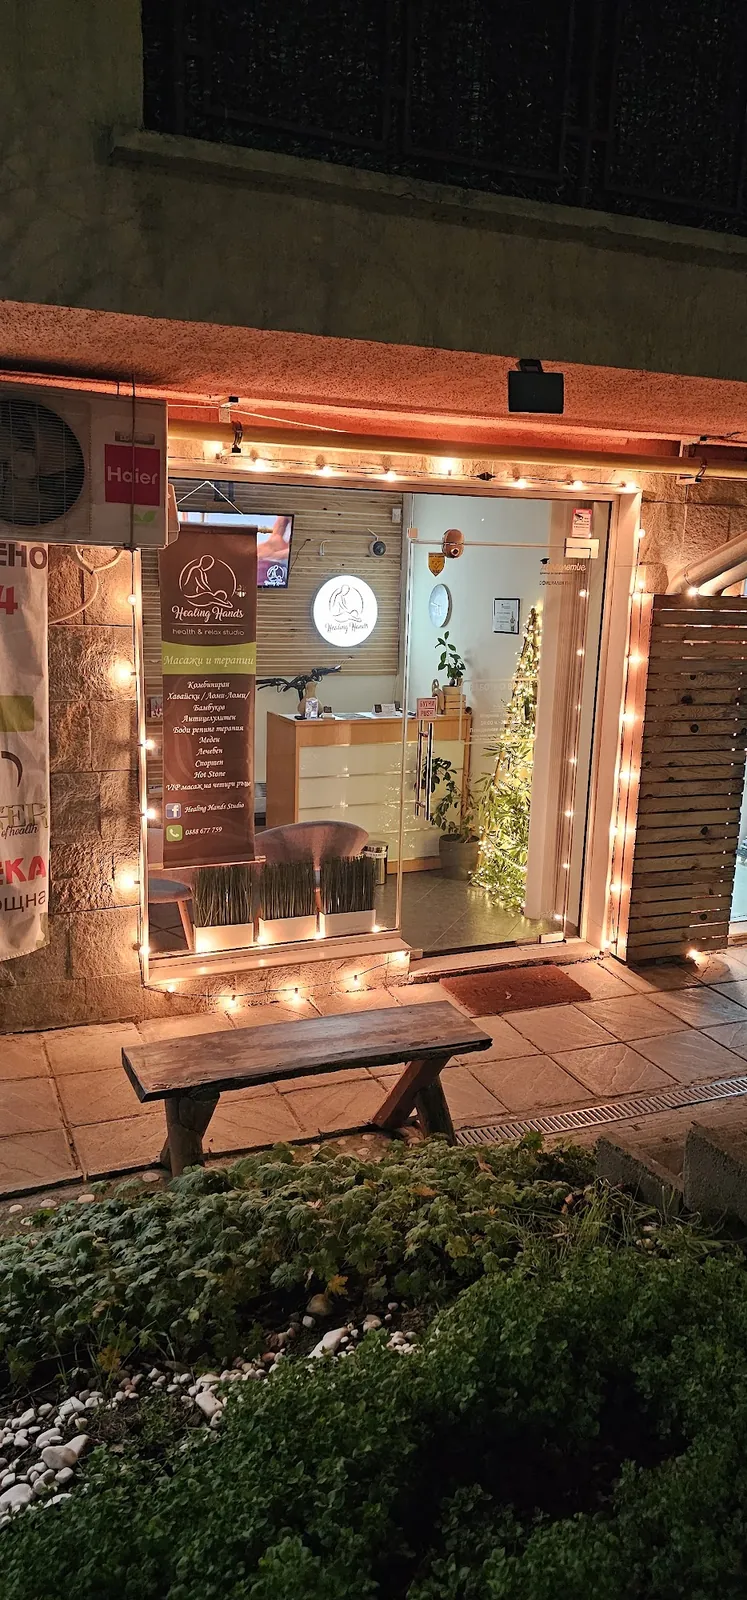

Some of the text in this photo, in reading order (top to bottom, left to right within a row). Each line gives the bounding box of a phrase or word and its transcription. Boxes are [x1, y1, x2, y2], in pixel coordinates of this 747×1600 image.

[107, 466, 158, 485] Haier
[171, 605, 244, 623] Healing Hands
[204, 628, 221, 636] relax
[222, 628, 245, 636] studio
[163, 655, 203, 667] Масажи
[214, 657, 254, 667] терапии
[187, 681, 230, 690] Комбиниран
[166, 692, 200, 701] Хавайски
[193, 702, 226, 713] Бамбуков
[172, 725, 191, 734] Боди
[193, 770, 226, 779] Hot Stone
[184, 804, 208, 813] Healing
[0, 856, 47, 885] КА
[0, 890, 46, 913] щна
